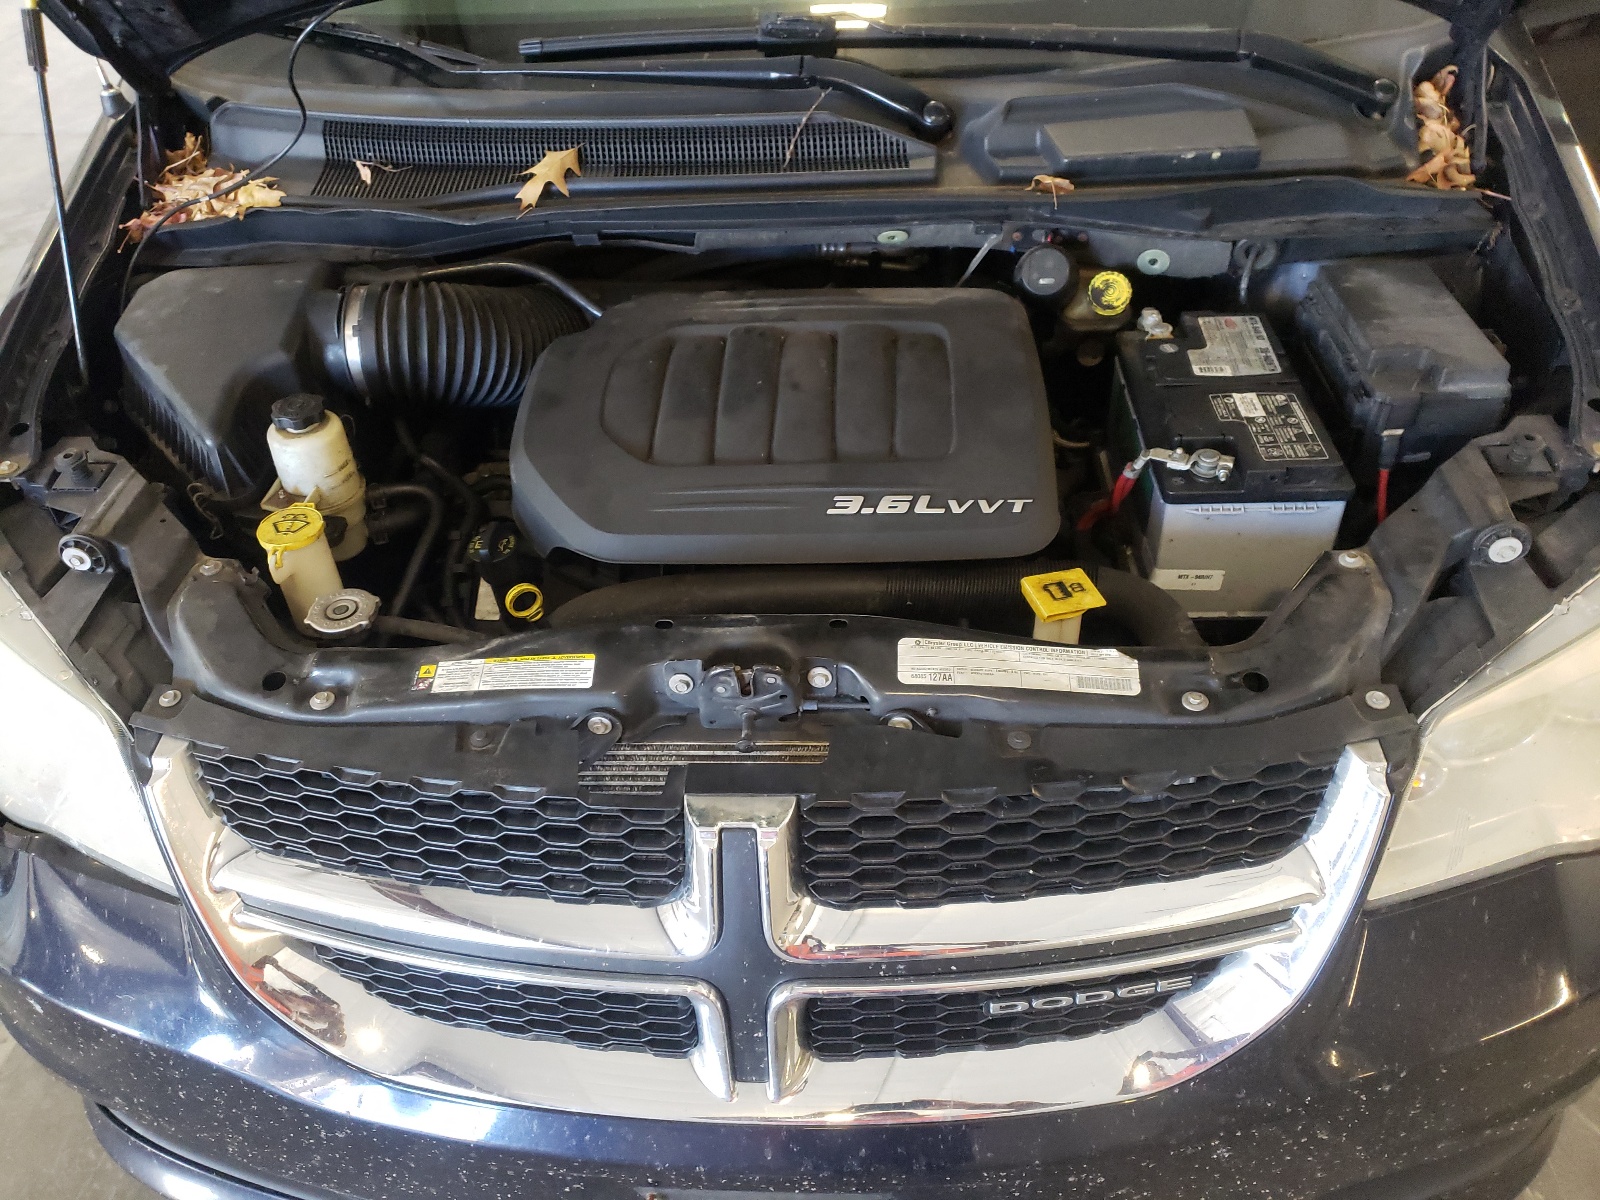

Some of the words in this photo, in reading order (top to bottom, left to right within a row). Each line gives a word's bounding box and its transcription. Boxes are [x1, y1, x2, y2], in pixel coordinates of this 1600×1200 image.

[1050, 647, 1086, 655] INFORMATION
[928, 673, 953, 682] 127AA
[989, 975, 1193, 1014] DODGE
